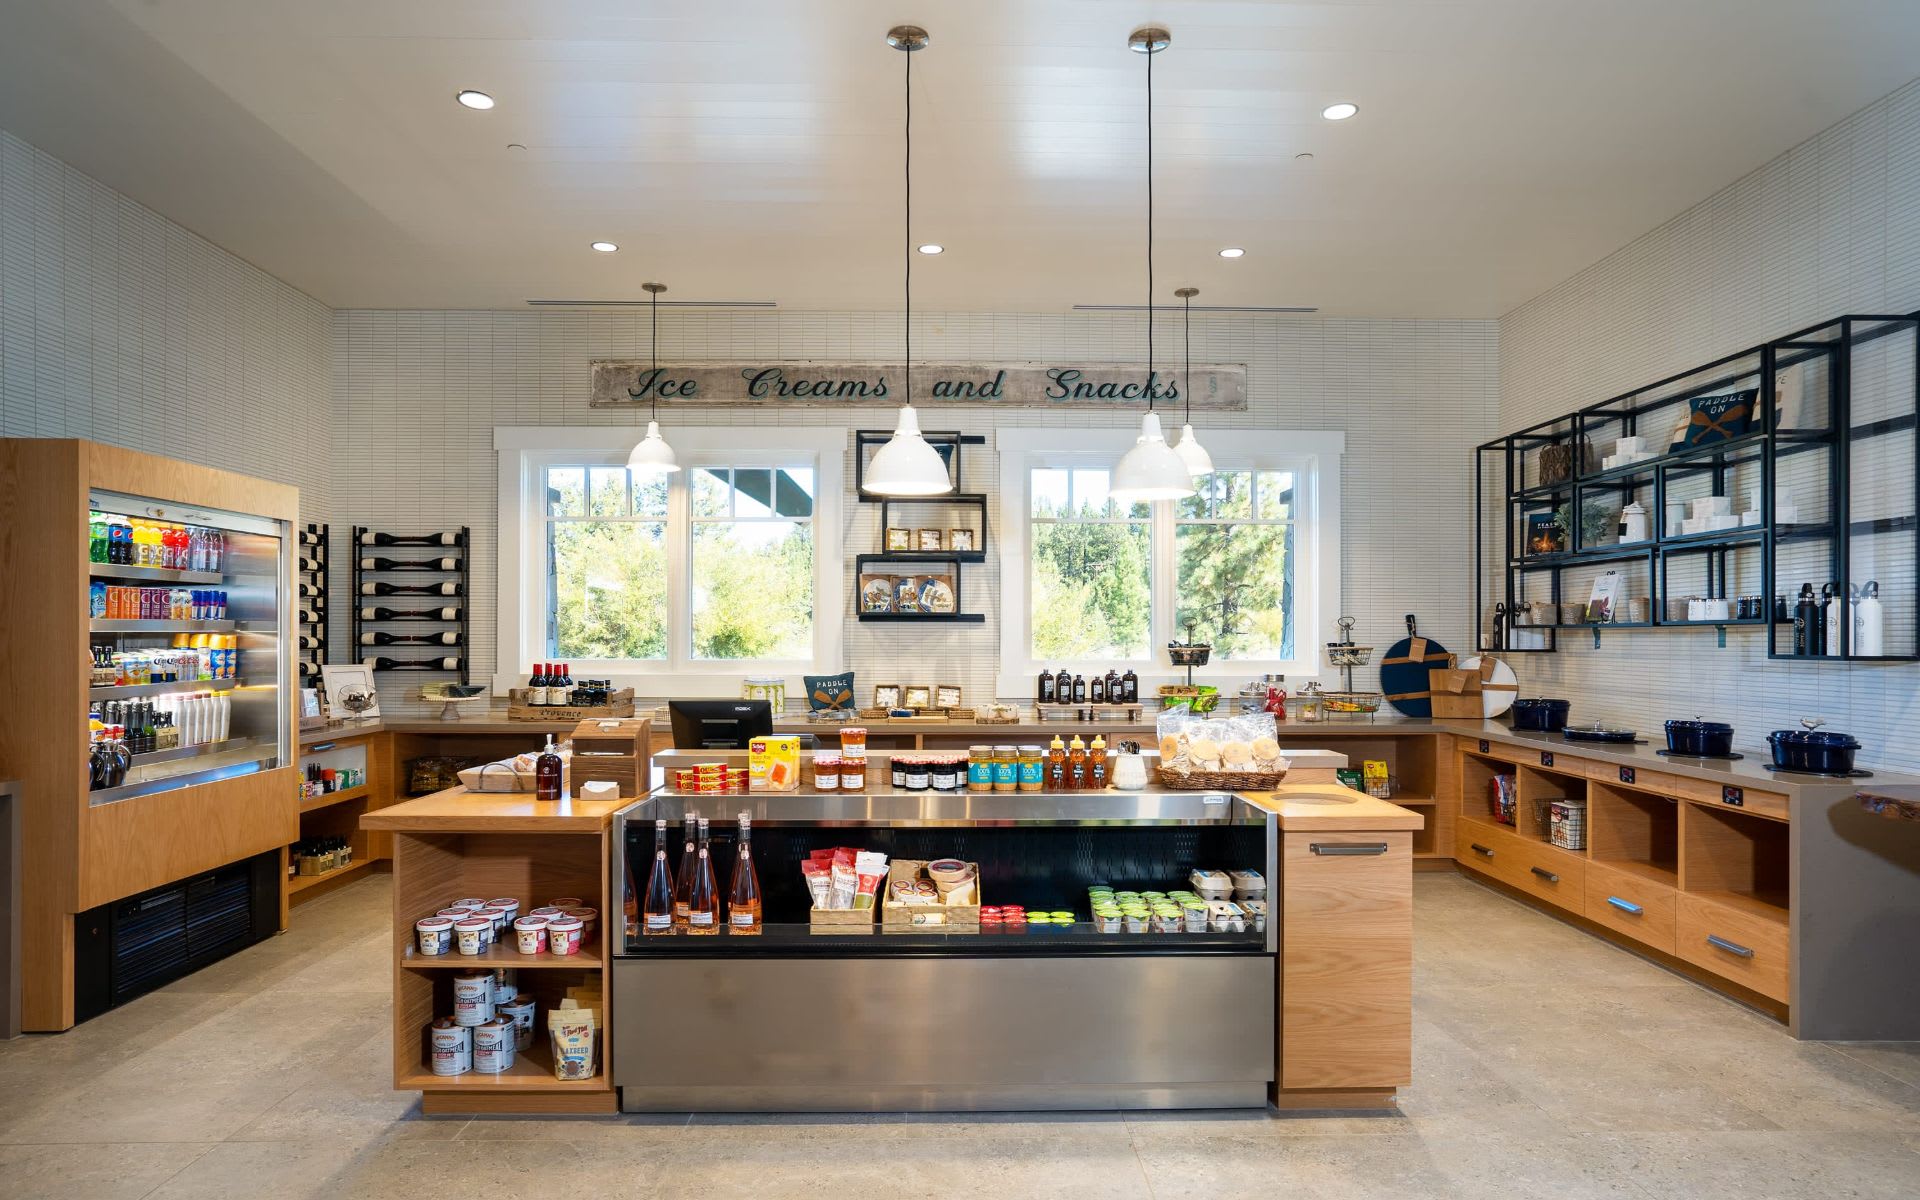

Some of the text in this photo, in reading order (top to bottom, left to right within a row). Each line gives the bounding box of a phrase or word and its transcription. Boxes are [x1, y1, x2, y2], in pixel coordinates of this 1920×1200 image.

[628, 367, 1181, 399] Ice Creams and Snacks
[1698, 393, 1745, 408] PADDLE
[1710, 404, 1726, 414] ON
[816, 679, 848, 688] PADDLE
[538, 708, 582, 718] Provence
